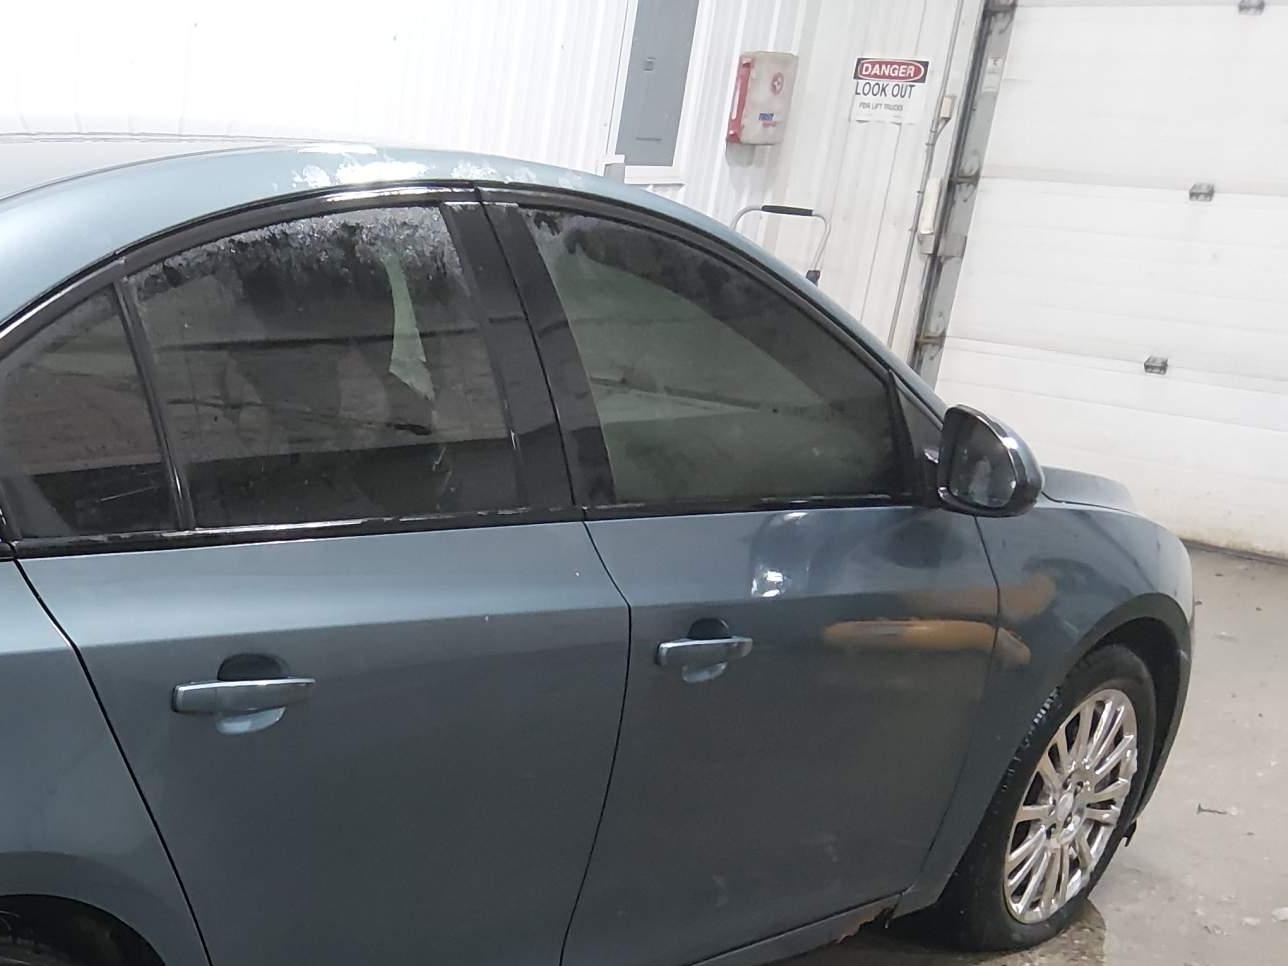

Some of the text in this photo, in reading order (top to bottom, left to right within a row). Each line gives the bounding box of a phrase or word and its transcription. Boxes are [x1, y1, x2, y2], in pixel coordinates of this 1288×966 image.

[862, 63, 915, 77] DANGER
[855, 81, 915, 99] LOOK OUT
